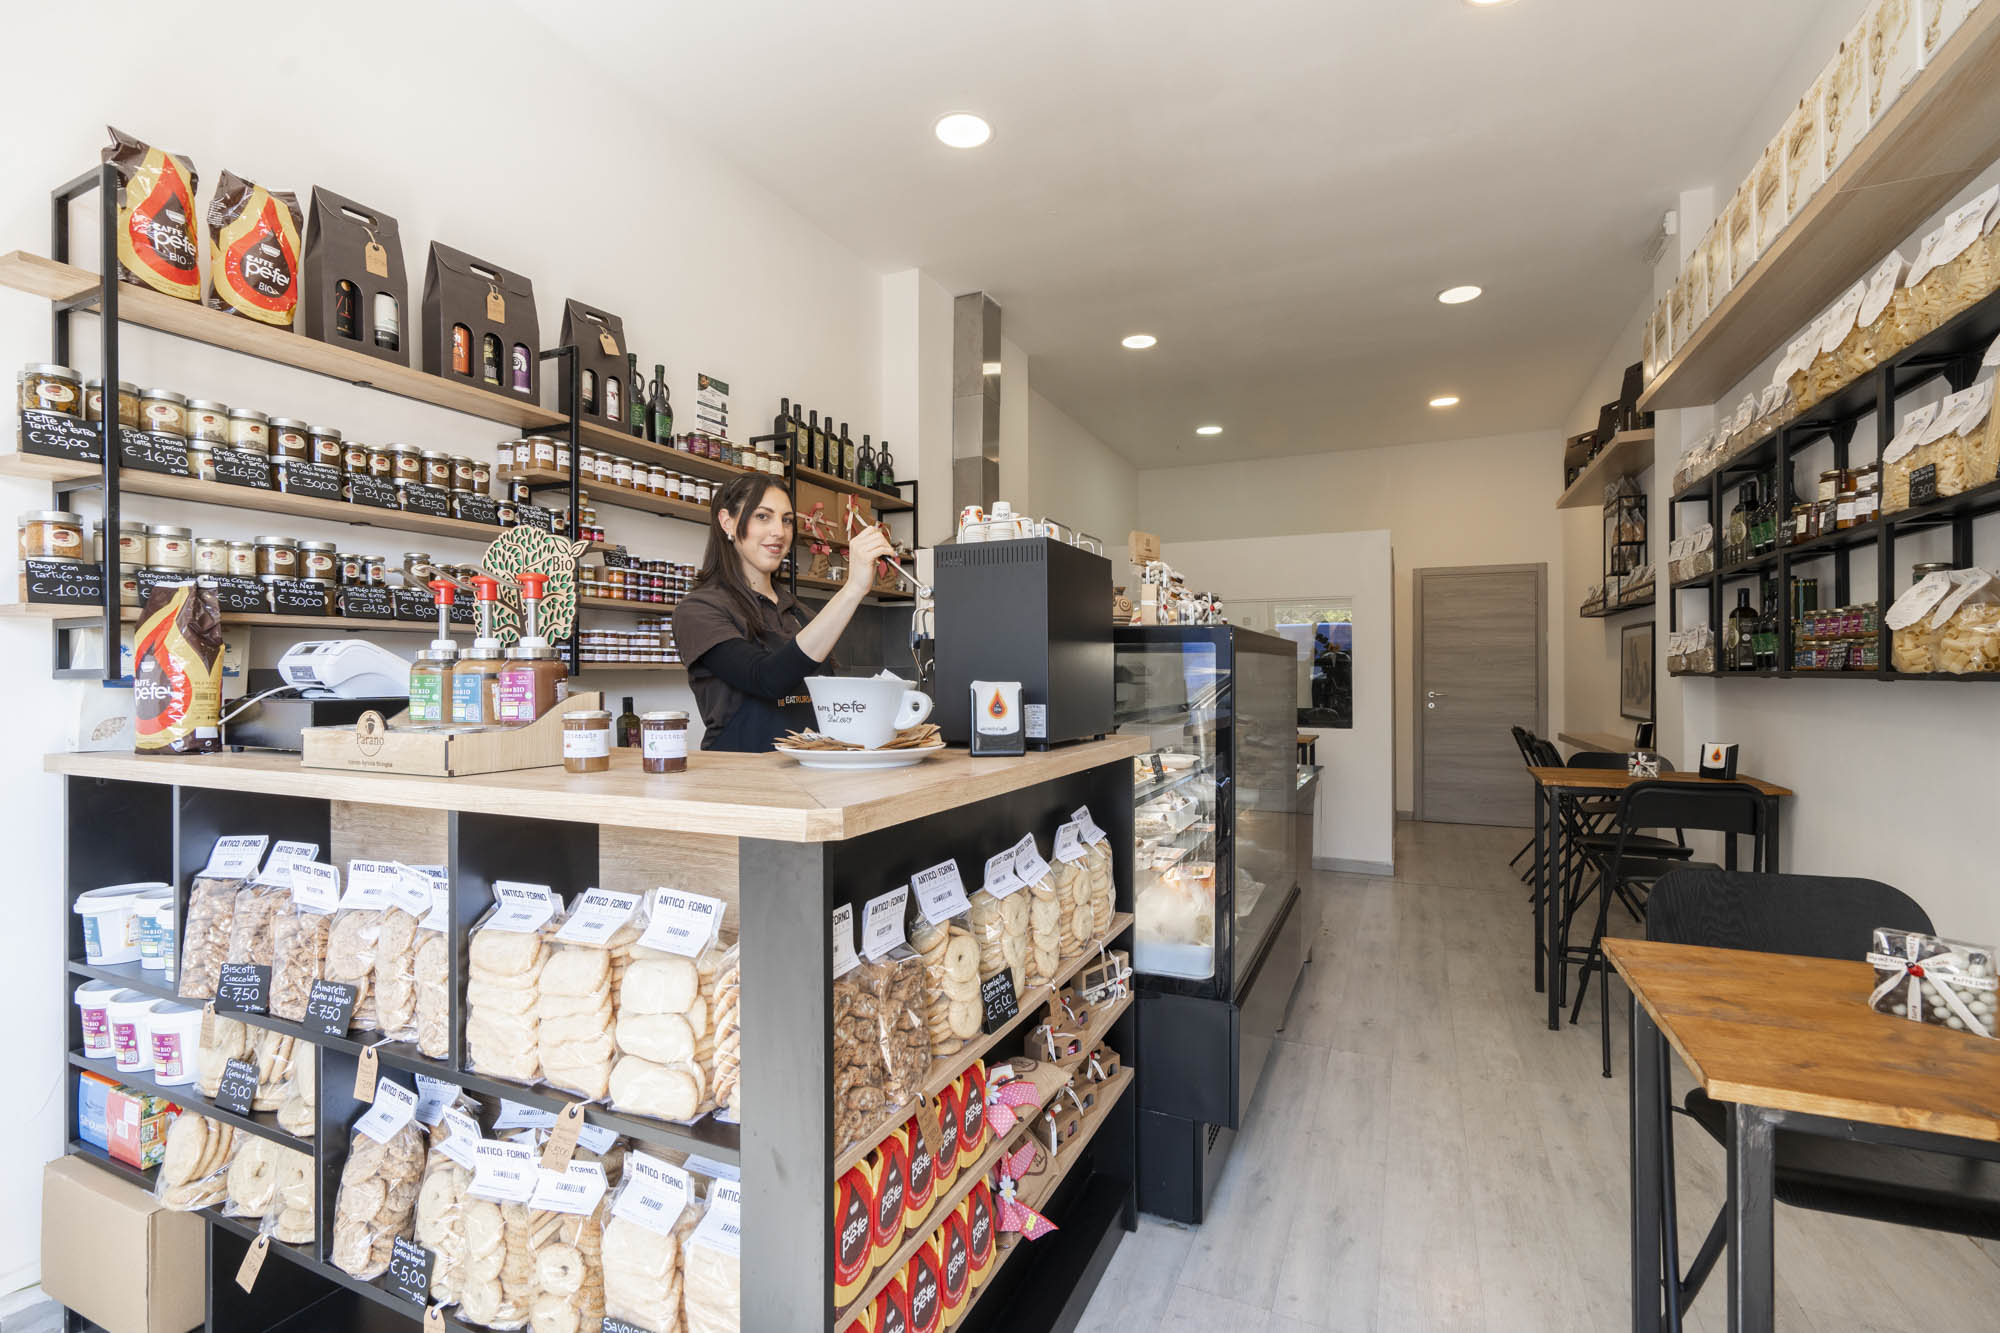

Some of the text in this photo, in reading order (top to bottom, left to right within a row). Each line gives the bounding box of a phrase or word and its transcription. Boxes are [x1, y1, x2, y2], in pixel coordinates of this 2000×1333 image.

[169, 253, 187, 265] BIO
[258, 281, 274, 294] BIO
[153, 436, 184, 446] Crema
[552, 555, 573, 572] Bio
[34, 571, 73, 583] Tartufo
[293, 864, 311, 874] ANTICO
[314, 868, 331, 878] FORNO
[353, 864, 374, 872] ANTICO
[918, 863, 955, 884] ANTICO FORNO
[433, 882, 448, 891] ANTIC
[501, 889, 547, 901] ANTICO FORNO
[584, 895, 633, 910] ANTICO FORNO
[658, 895, 712, 915] ANTICO FORNO
[872, 900, 890, 915] ANTICO
[381, 1082, 397, 1097] ANTICO
[398, 1091, 413, 1106] FORNO
[476, 1146, 530, 1160] ANTICO FORNO
[636, 1163, 683, 1189] ANTICO FORNO
